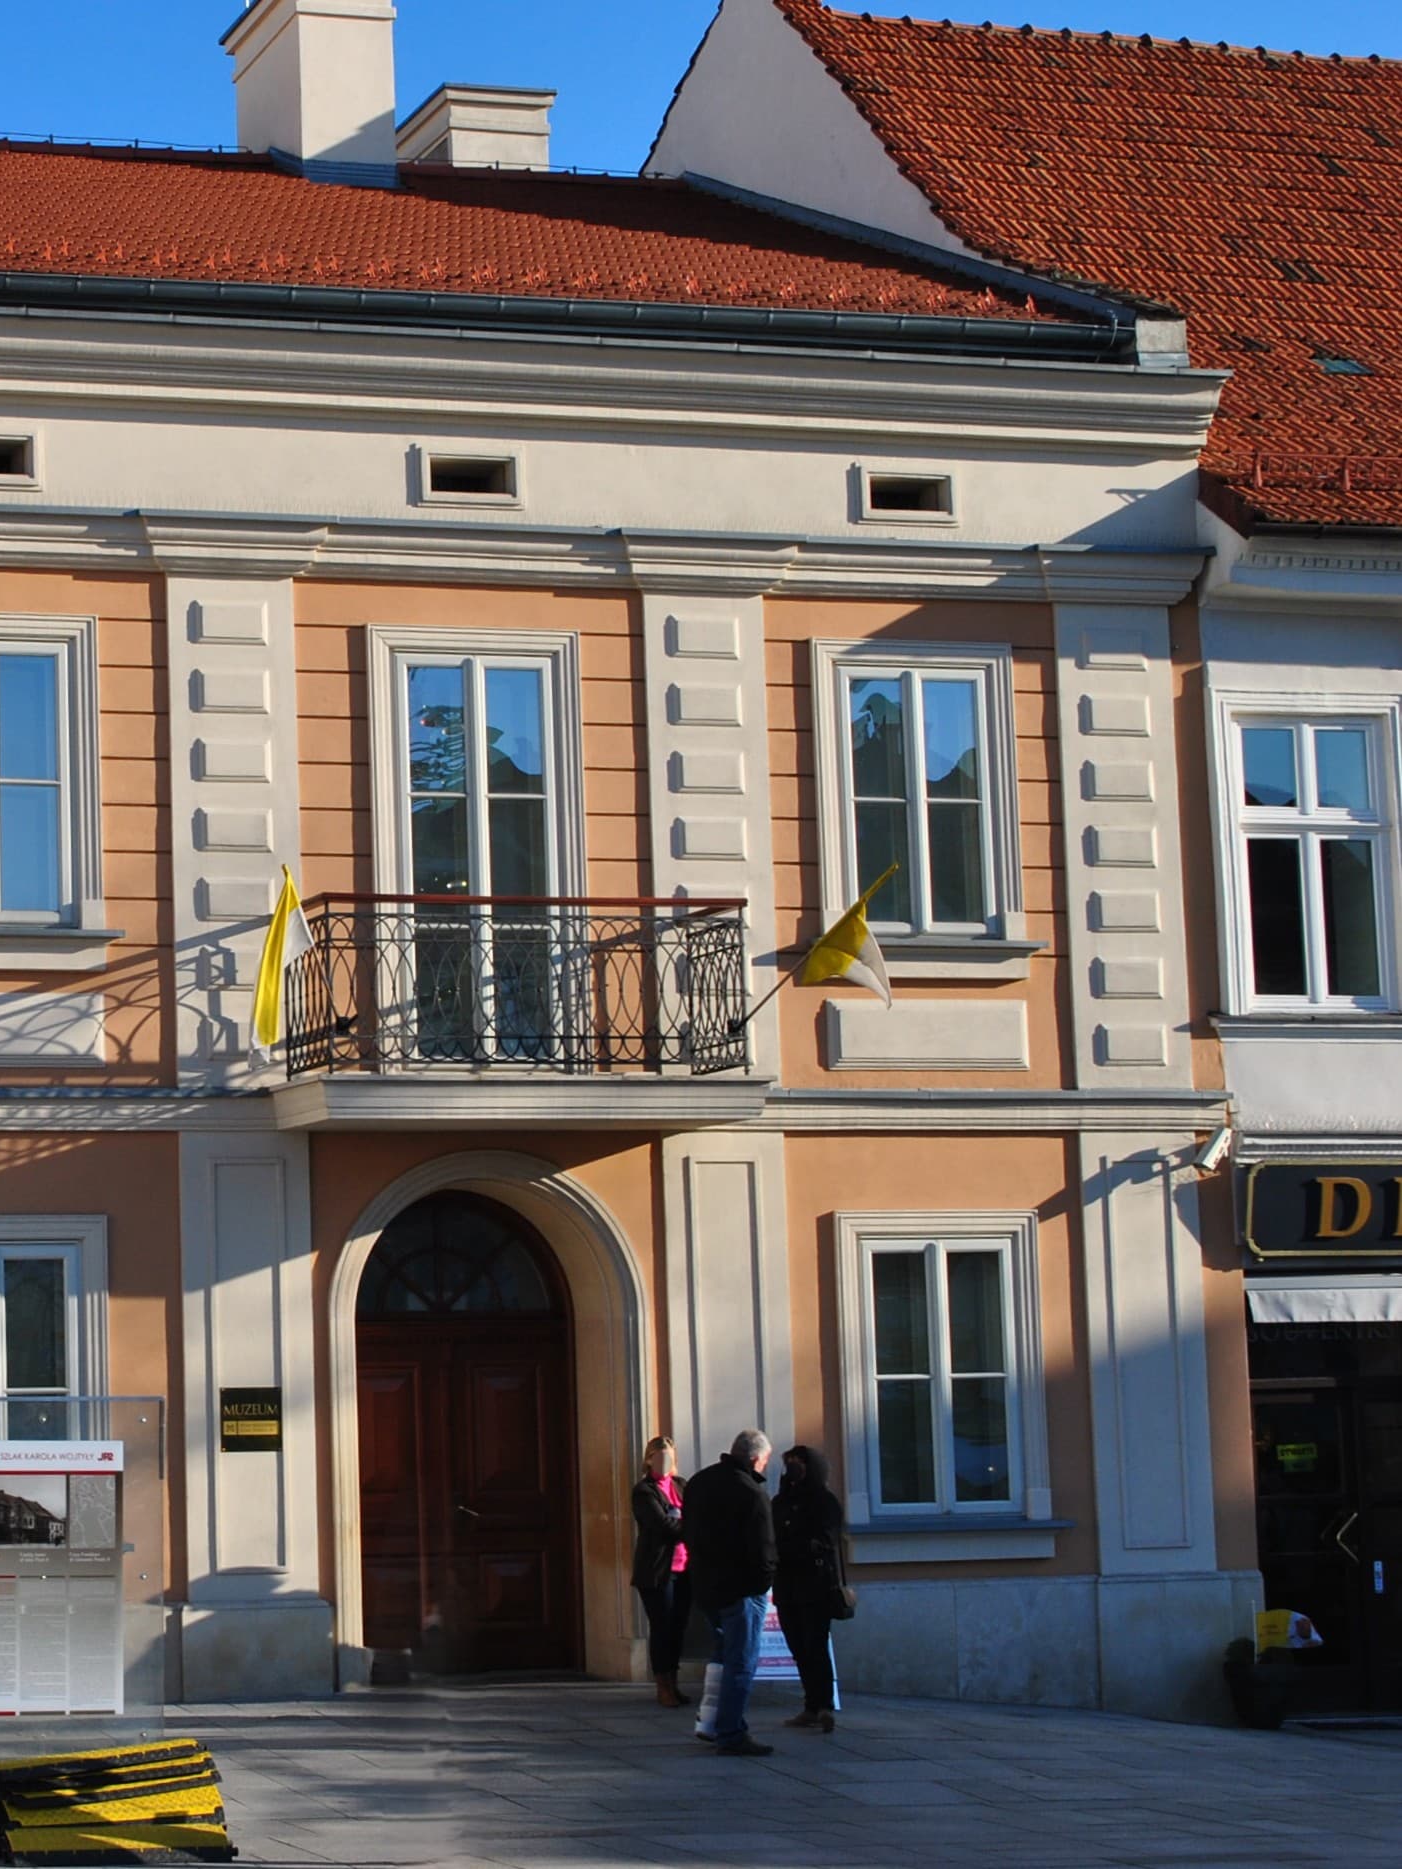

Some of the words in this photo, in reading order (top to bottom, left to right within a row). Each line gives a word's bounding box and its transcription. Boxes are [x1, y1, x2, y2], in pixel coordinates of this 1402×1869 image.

[222, 1403, 278, 1416] MUZEUM
[0, 1452, 22, 1461] SZLAK
[25, 1452, 56, 1461] KAROLA
